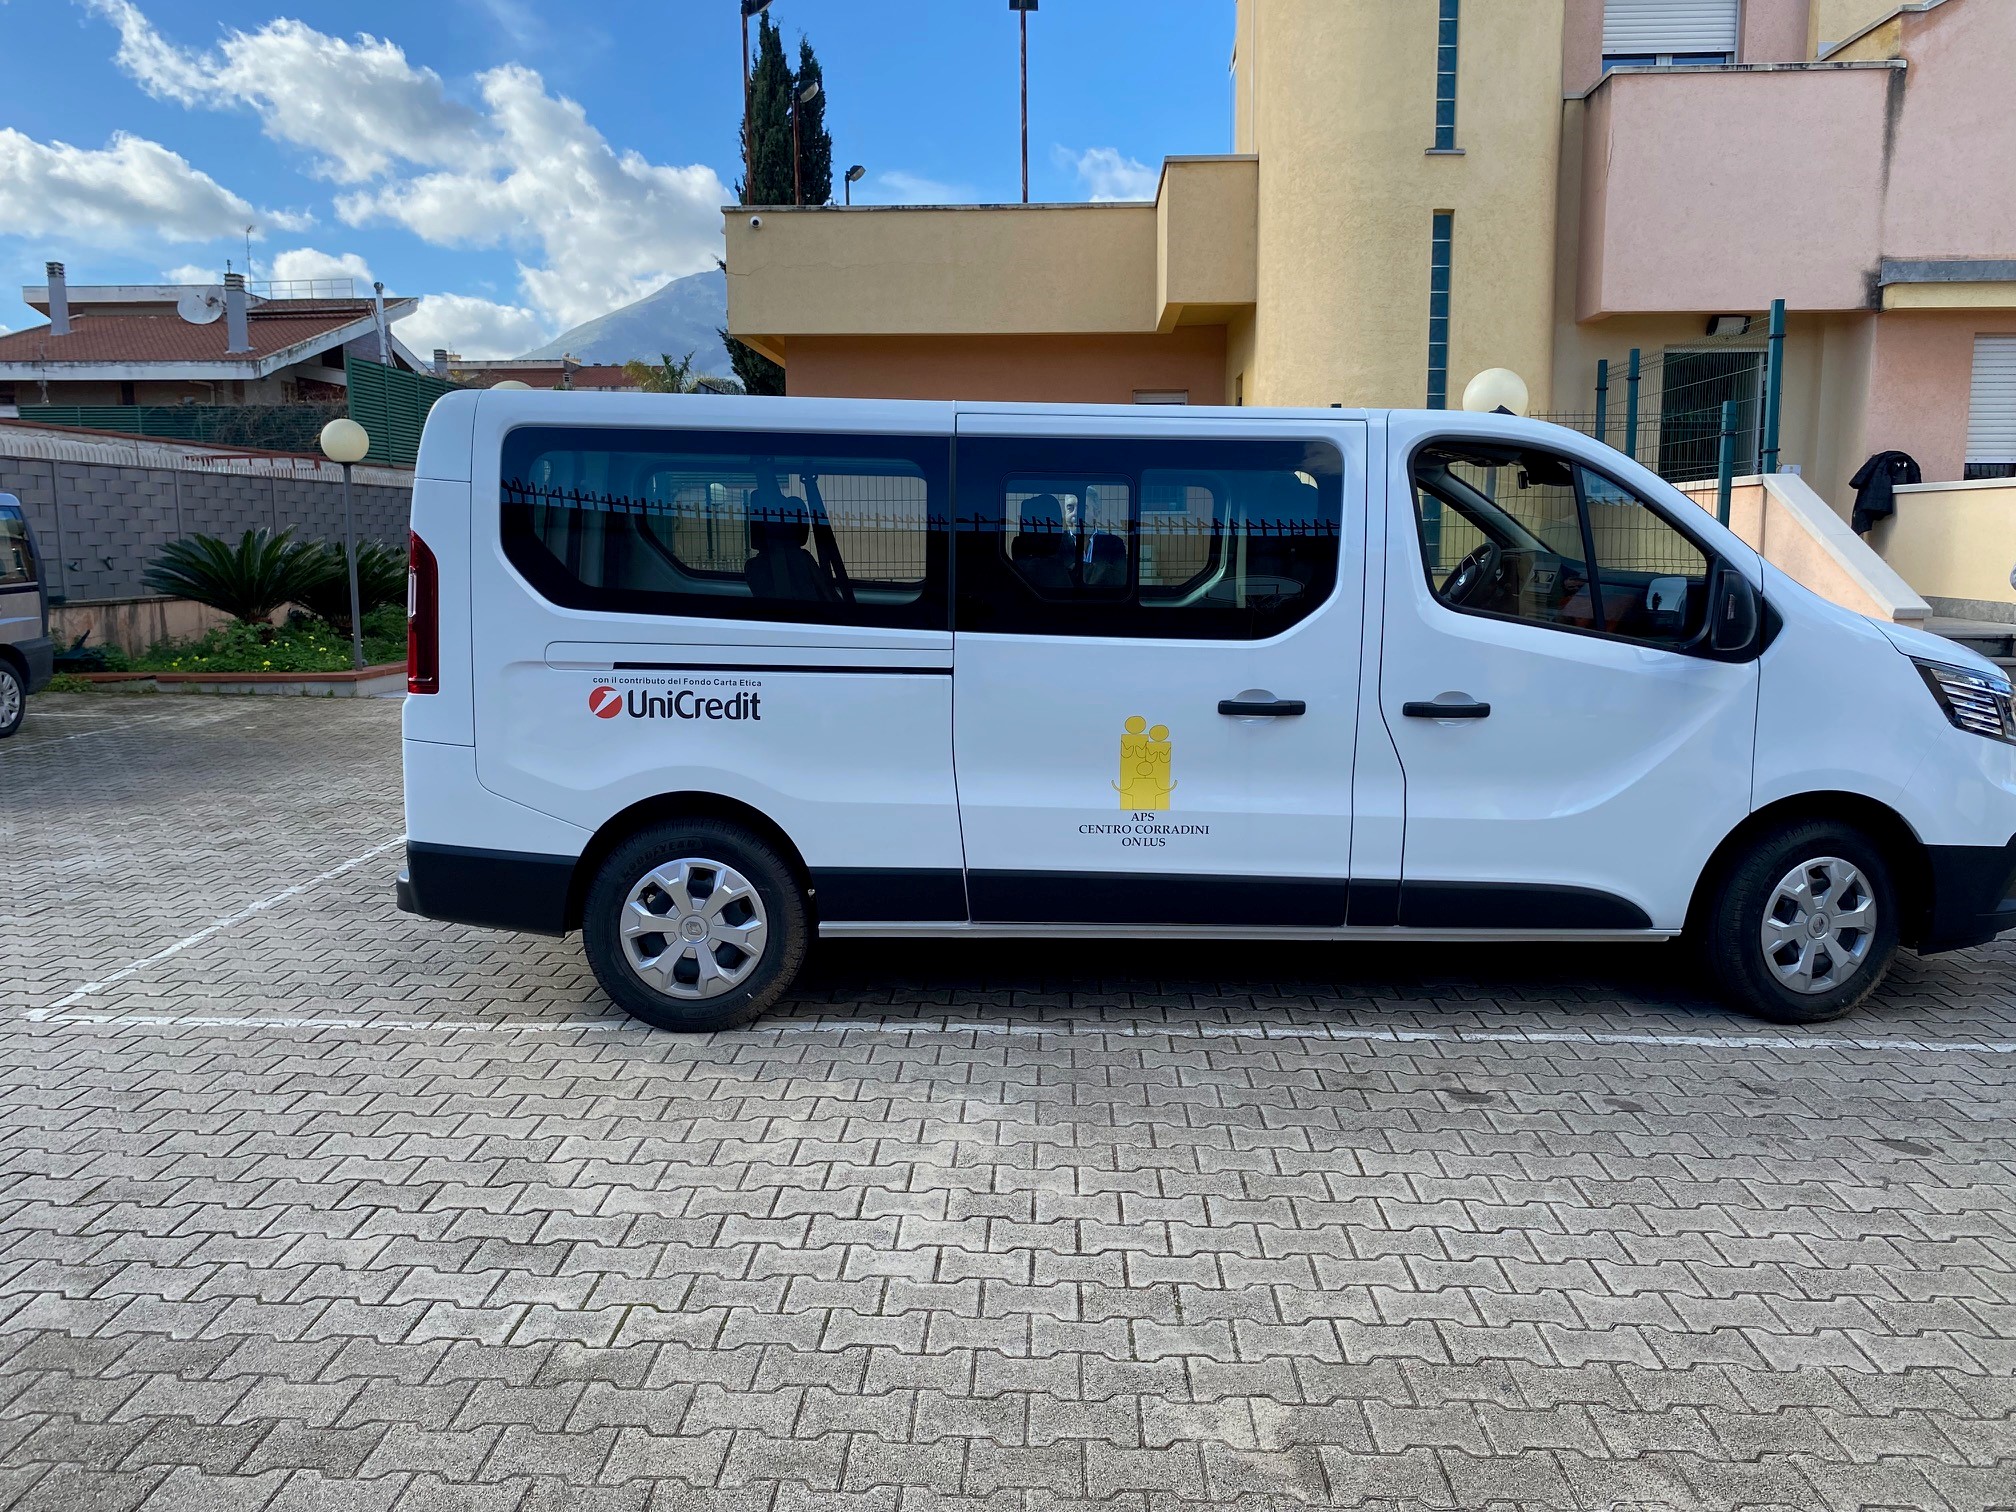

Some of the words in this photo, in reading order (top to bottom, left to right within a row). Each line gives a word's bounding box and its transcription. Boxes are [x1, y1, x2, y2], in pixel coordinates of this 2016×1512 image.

[611, 676, 617, 684] il
[619, 677, 665, 685] contributo
[667, 677, 681, 685] del
[683, 677, 711, 686] Fondo
[714, 678, 737, 687] Carta
[739, 679, 762, 687] Etica
[627, 689, 761, 720] UniCredit
[1131, 812, 1155, 822] APS
[1078, 824, 1131, 834] CENTRO
[1135, 824, 1210, 835] CORRADINI
[1121, 837, 1166, 847] ONLUS
